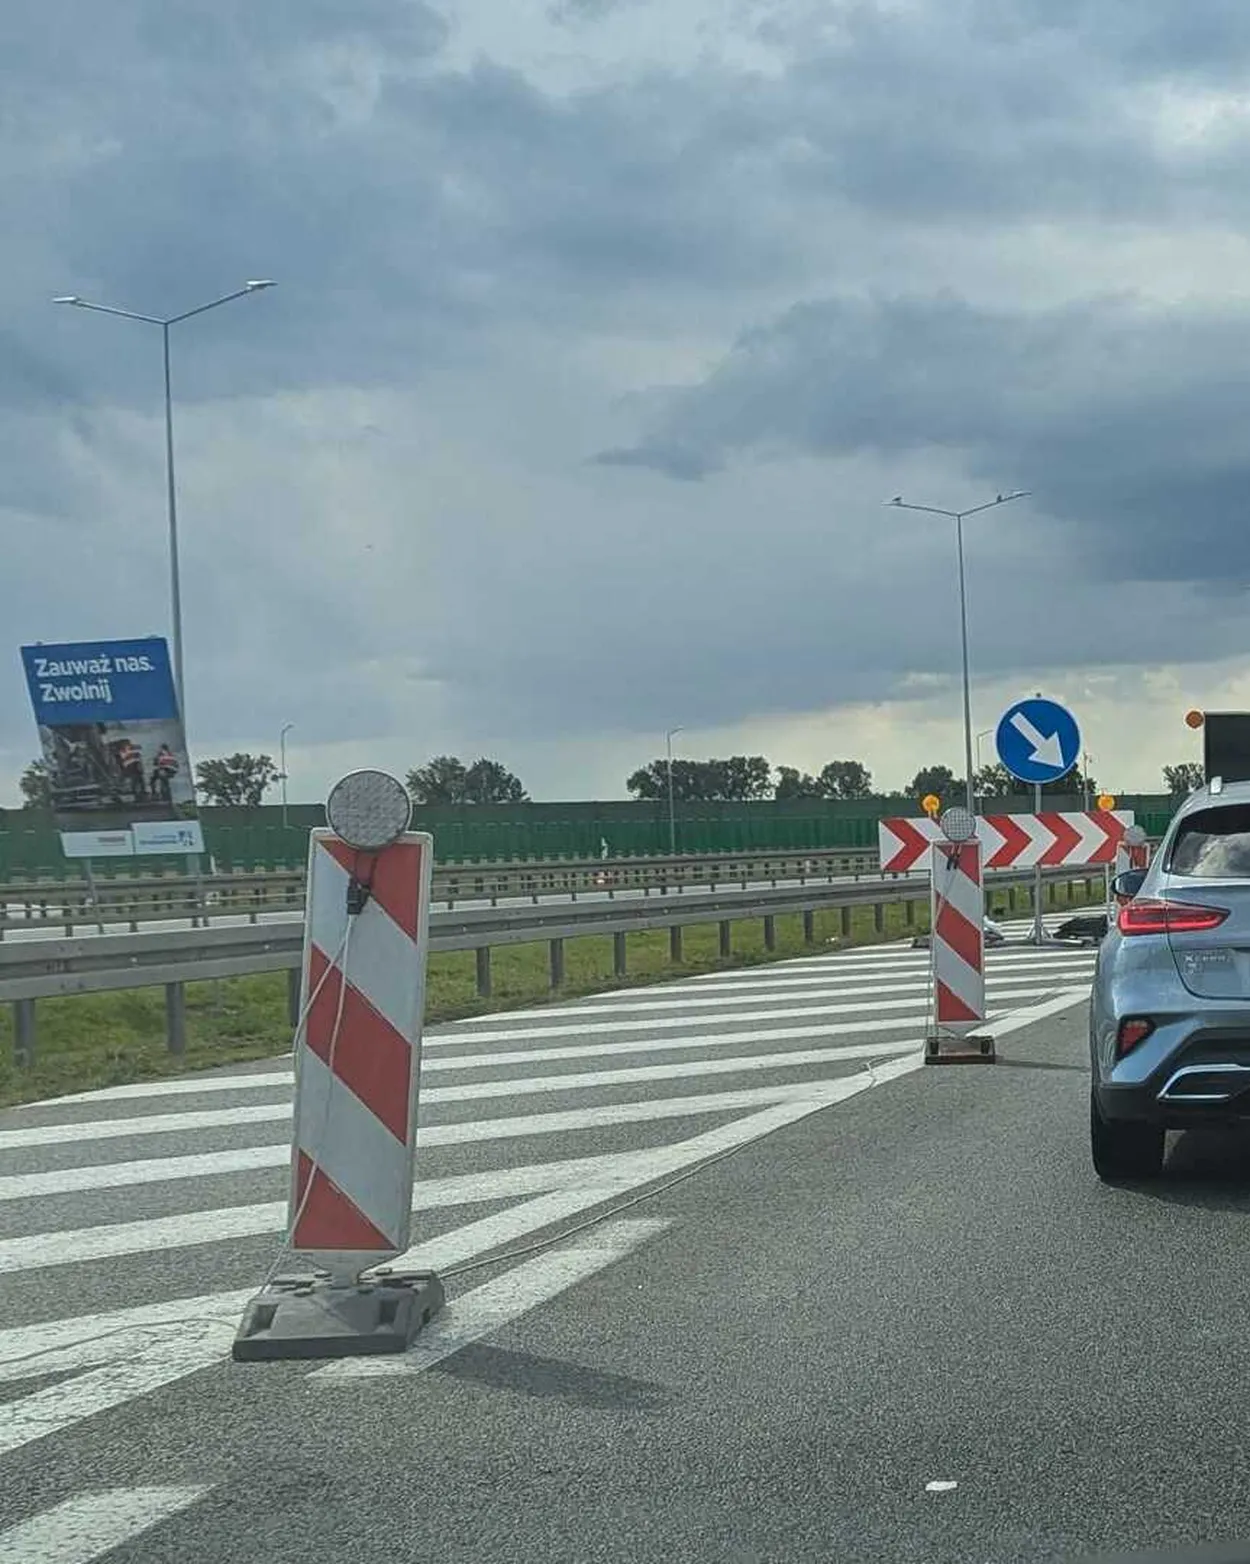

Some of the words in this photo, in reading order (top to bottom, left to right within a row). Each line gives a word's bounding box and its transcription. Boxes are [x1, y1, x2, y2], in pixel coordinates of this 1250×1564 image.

[34, 653, 113, 677] Zauważ
[115, 655, 156, 673] nas.
[40, 679, 112, 703] Zwolnij
